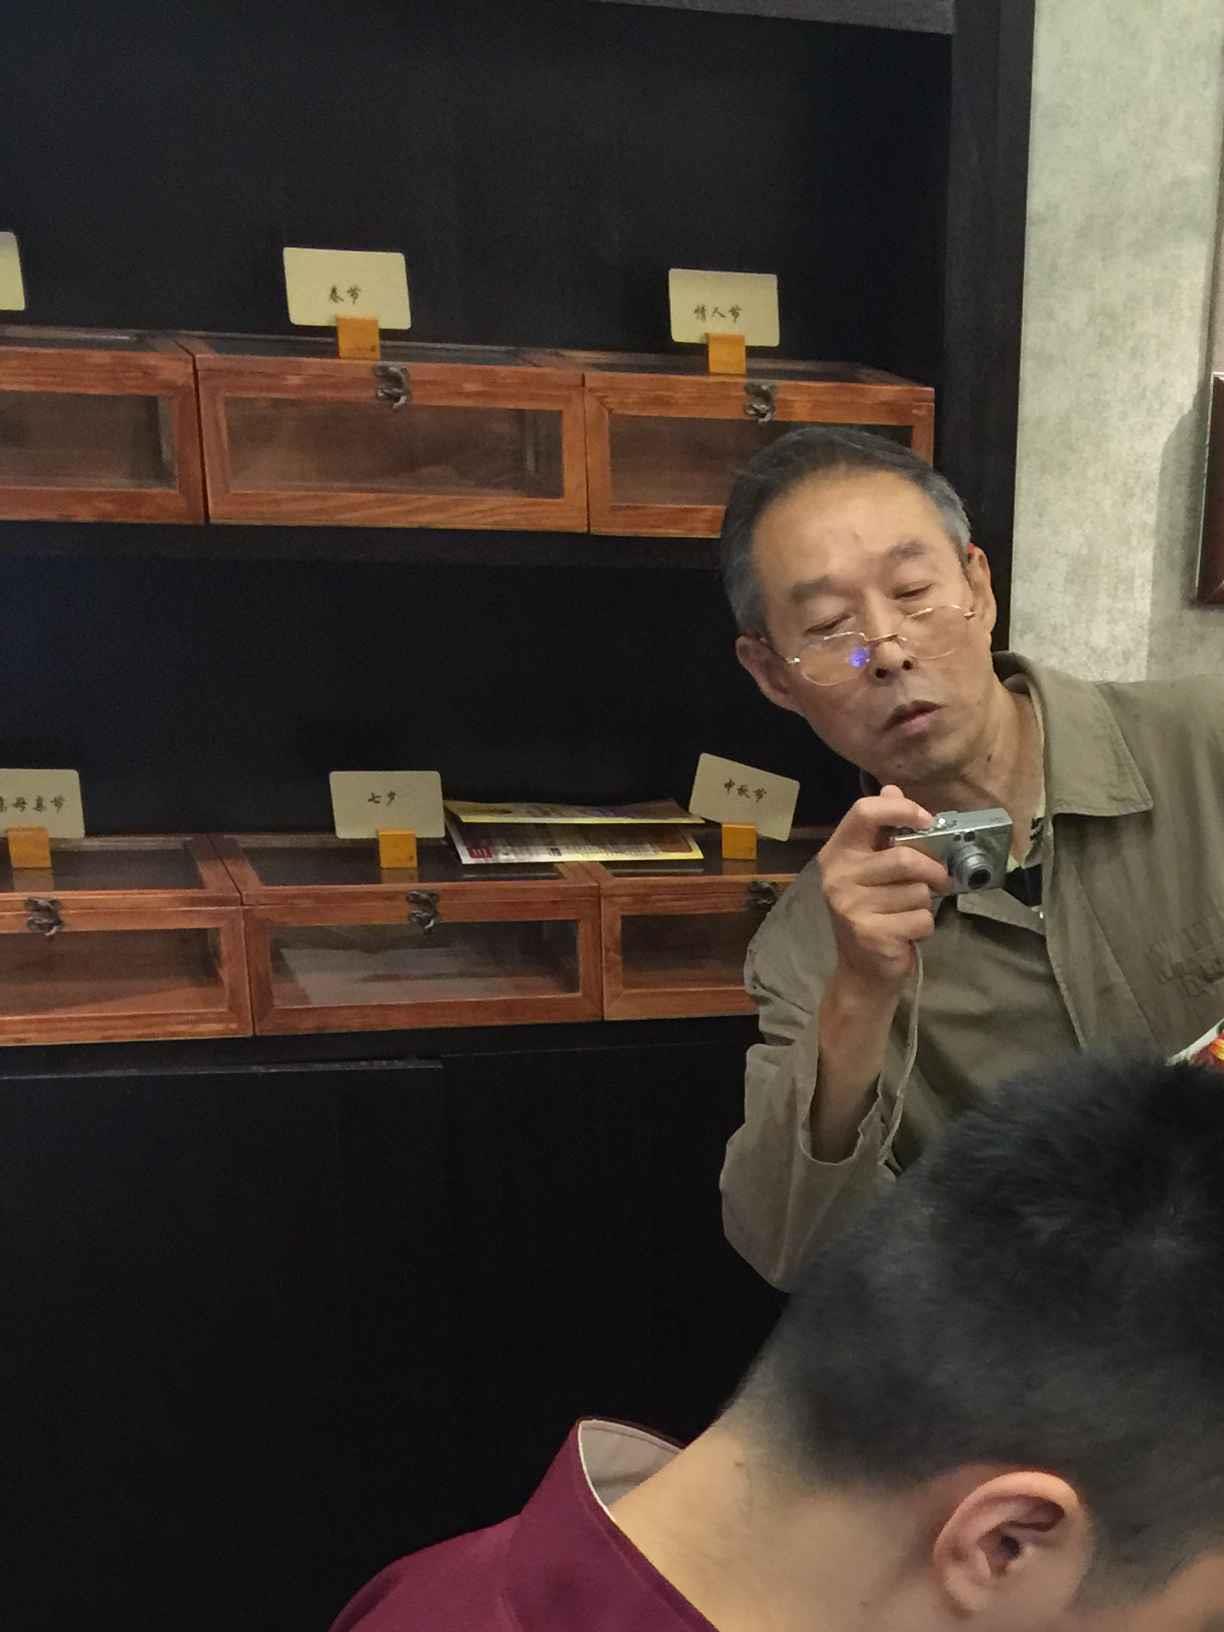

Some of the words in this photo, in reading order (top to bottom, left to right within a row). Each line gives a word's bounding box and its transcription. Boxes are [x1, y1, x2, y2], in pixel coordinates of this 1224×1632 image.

[693, 304, 743, 323] 情人节
[367, 790, 397, 807] 七夕
[723, 779, 768, 803] 中秋节
